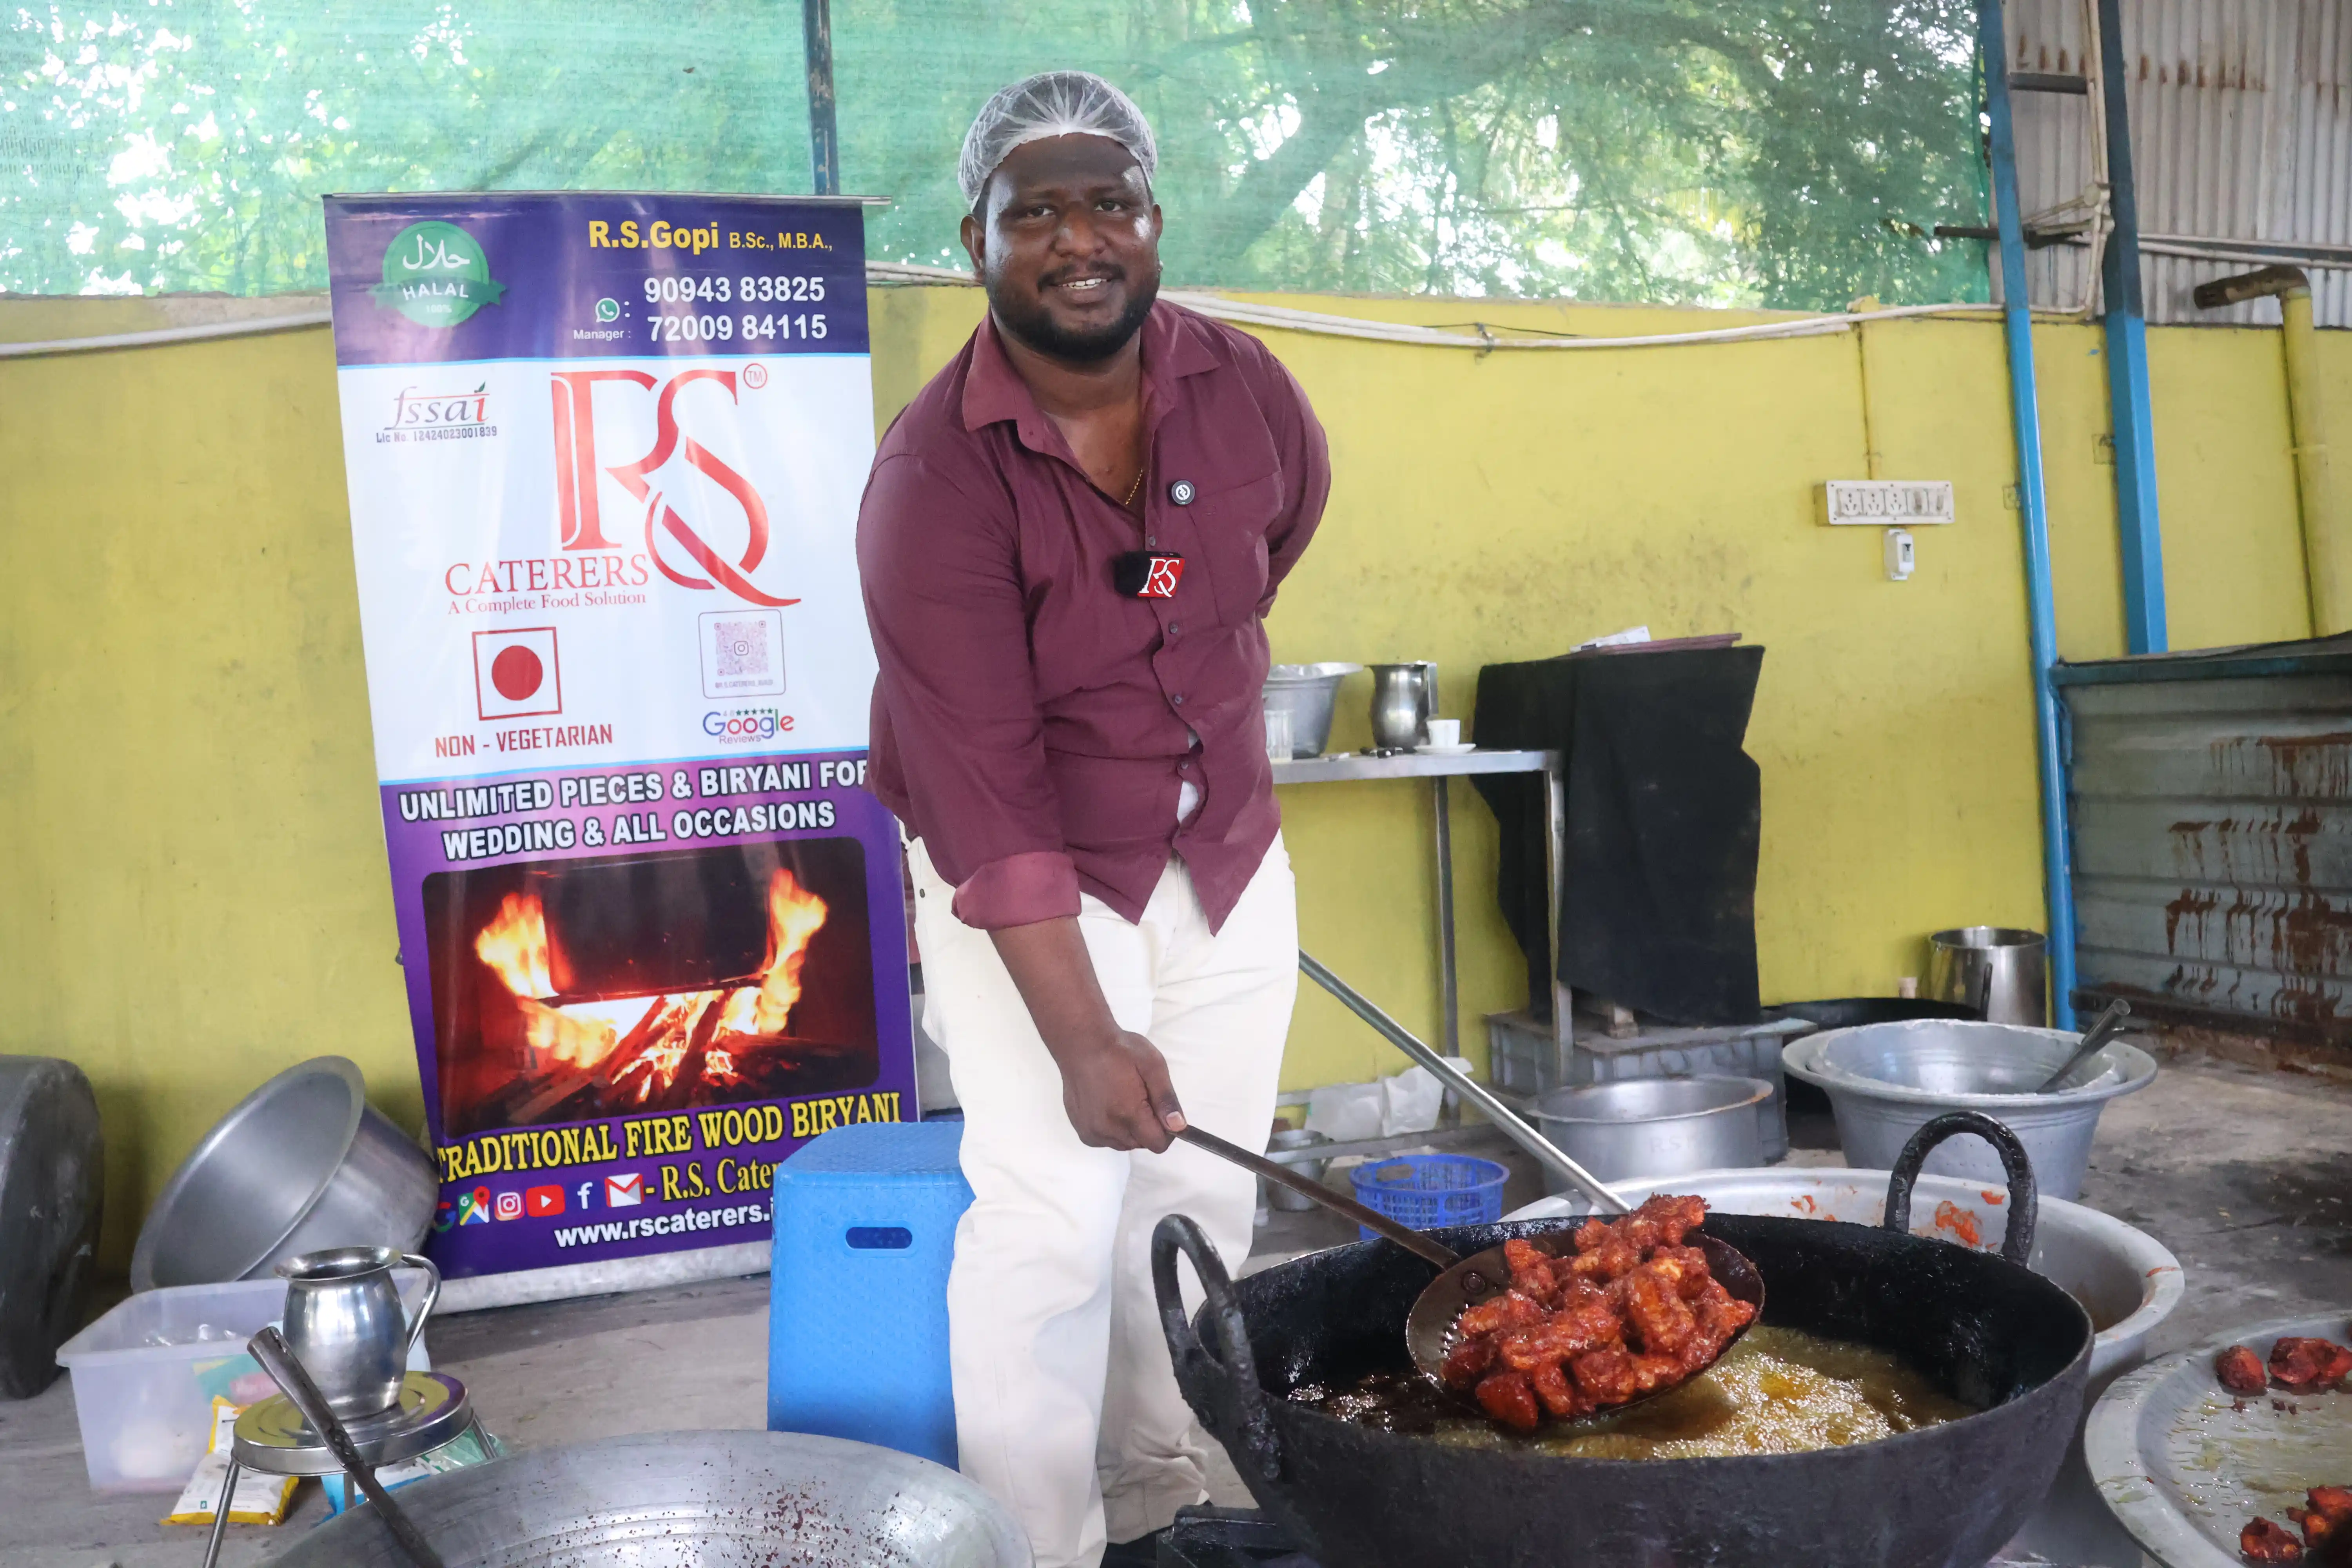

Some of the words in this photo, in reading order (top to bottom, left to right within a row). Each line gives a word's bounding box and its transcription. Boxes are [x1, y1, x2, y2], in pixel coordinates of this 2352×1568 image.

[402, 233, 470, 269] حلال
[589, 220, 719, 255] R.S.Gopi
[729, 232, 774, 251] B.Sc.,
[778, 232, 832, 252] M.B.A.,
[402, 282, 469, 300] HALAL
[644, 276, 731, 303] 90943
[740, 276, 825, 302] 83825
[573, 330, 624, 341] Manager
[647, 315, 733, 341] 72009
[742, 314, 828, 340] 84115
[747, 370, 763, 383] TM
[383, 381, 490, 430] fssai
[414, 426, 497, 441] 12424023001839
[445, 554, 649, 596] CATERERS
[448, 601, 460, 615] A
[465, 596, 536, 615] Complete
[541, 593, 580, 609] Food
[584, 590, 646, 606] Solution
[703, 708, 794, 739] Google
[719, 735, 762, 744] Reviews
[435, 734, 475, 758] NON
[496, 724, 613, 752] VEGETARIAN
[399, 779, 553, 822] UNLIMITED
[561, 773, 663, 808] PIECES
[672, 771, 693, 799] &
[700, 762, 811, 797] BIRYANI
[443, 819, 575, 860] WEDDING
[584, 818, 605, 847] &
[612, 814, 666, 844] ALL
[673, 802, 836, 839] OCCASIONS
[624, 1116, 692, 1157] FIRE
[698, 1105, 783, 1148] WOOD
[790, 1092, 902, 1138] BIRYANI
[661, 1161, 711, 1201] R.S.
